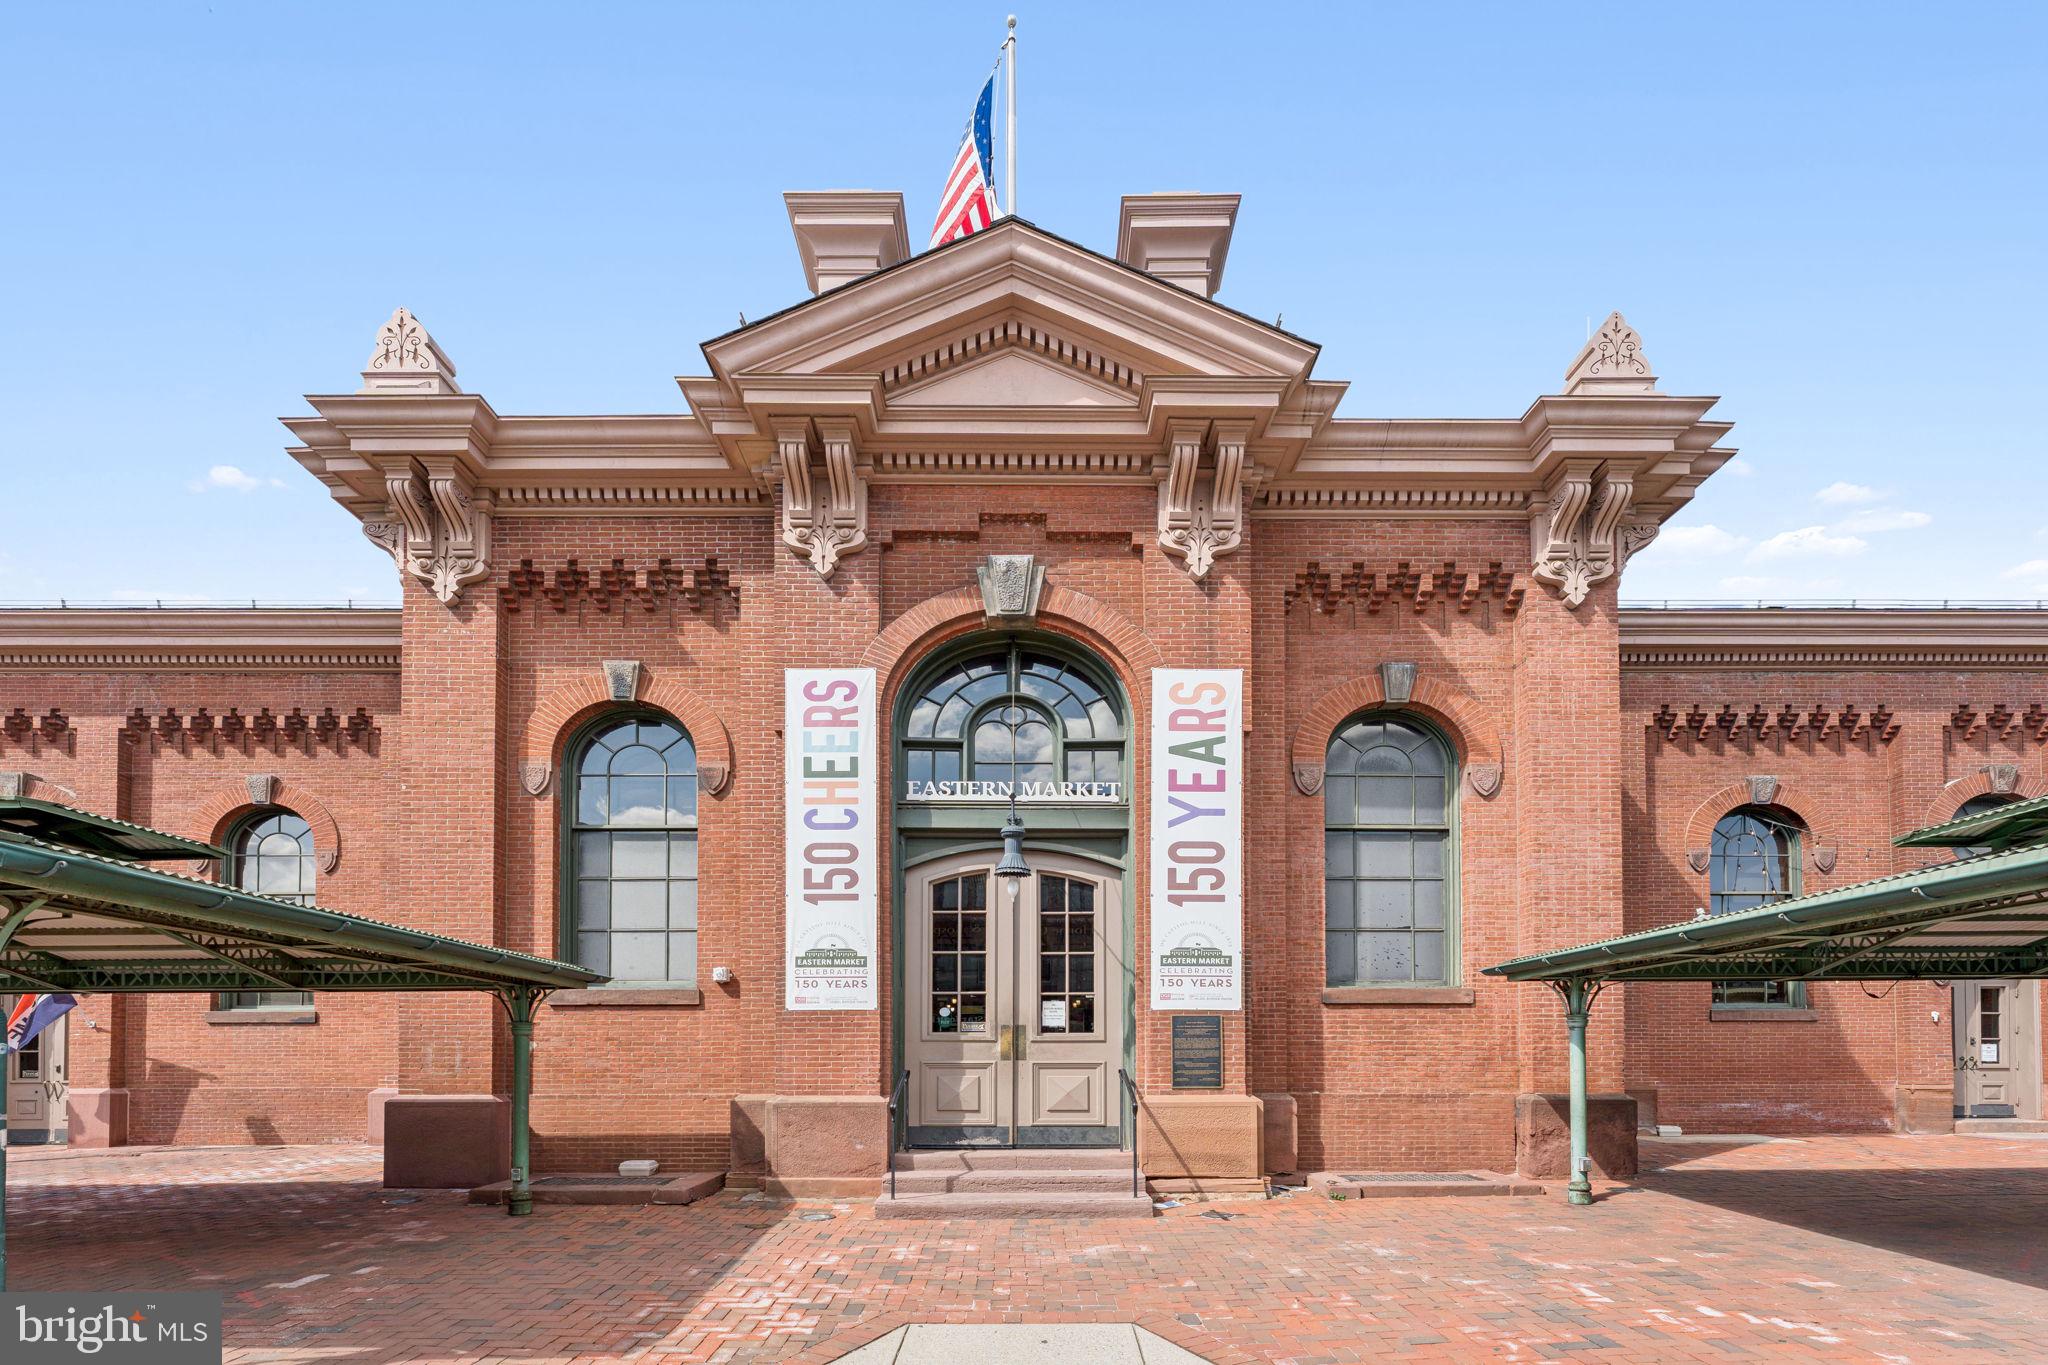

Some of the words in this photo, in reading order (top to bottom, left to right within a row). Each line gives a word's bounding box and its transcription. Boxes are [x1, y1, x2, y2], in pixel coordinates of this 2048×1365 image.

[803, 680, 859, 830] CHEERS
[1168, 682, 1226, 828] YEARS
[907, 781, 1014, 797] EASTERN
[1021, 782, 1121, 797] MARKET
[803, 842, 859, 906] 150
[1168, 841, 1226, 907] 150
[797, 958, 832, 966] EASTERN
[833, 958, 865, 966] MARKET
[1162, 957, 1197, 965] EASTERN
[1198, 957, 1230, 965] MARKET
[795, 980, 819, 988] 150
[826, 980, 868, 988] YEARS
[1160, 979, 1184, 987] 150
[1190, 979, 1233, 987] YEARS
